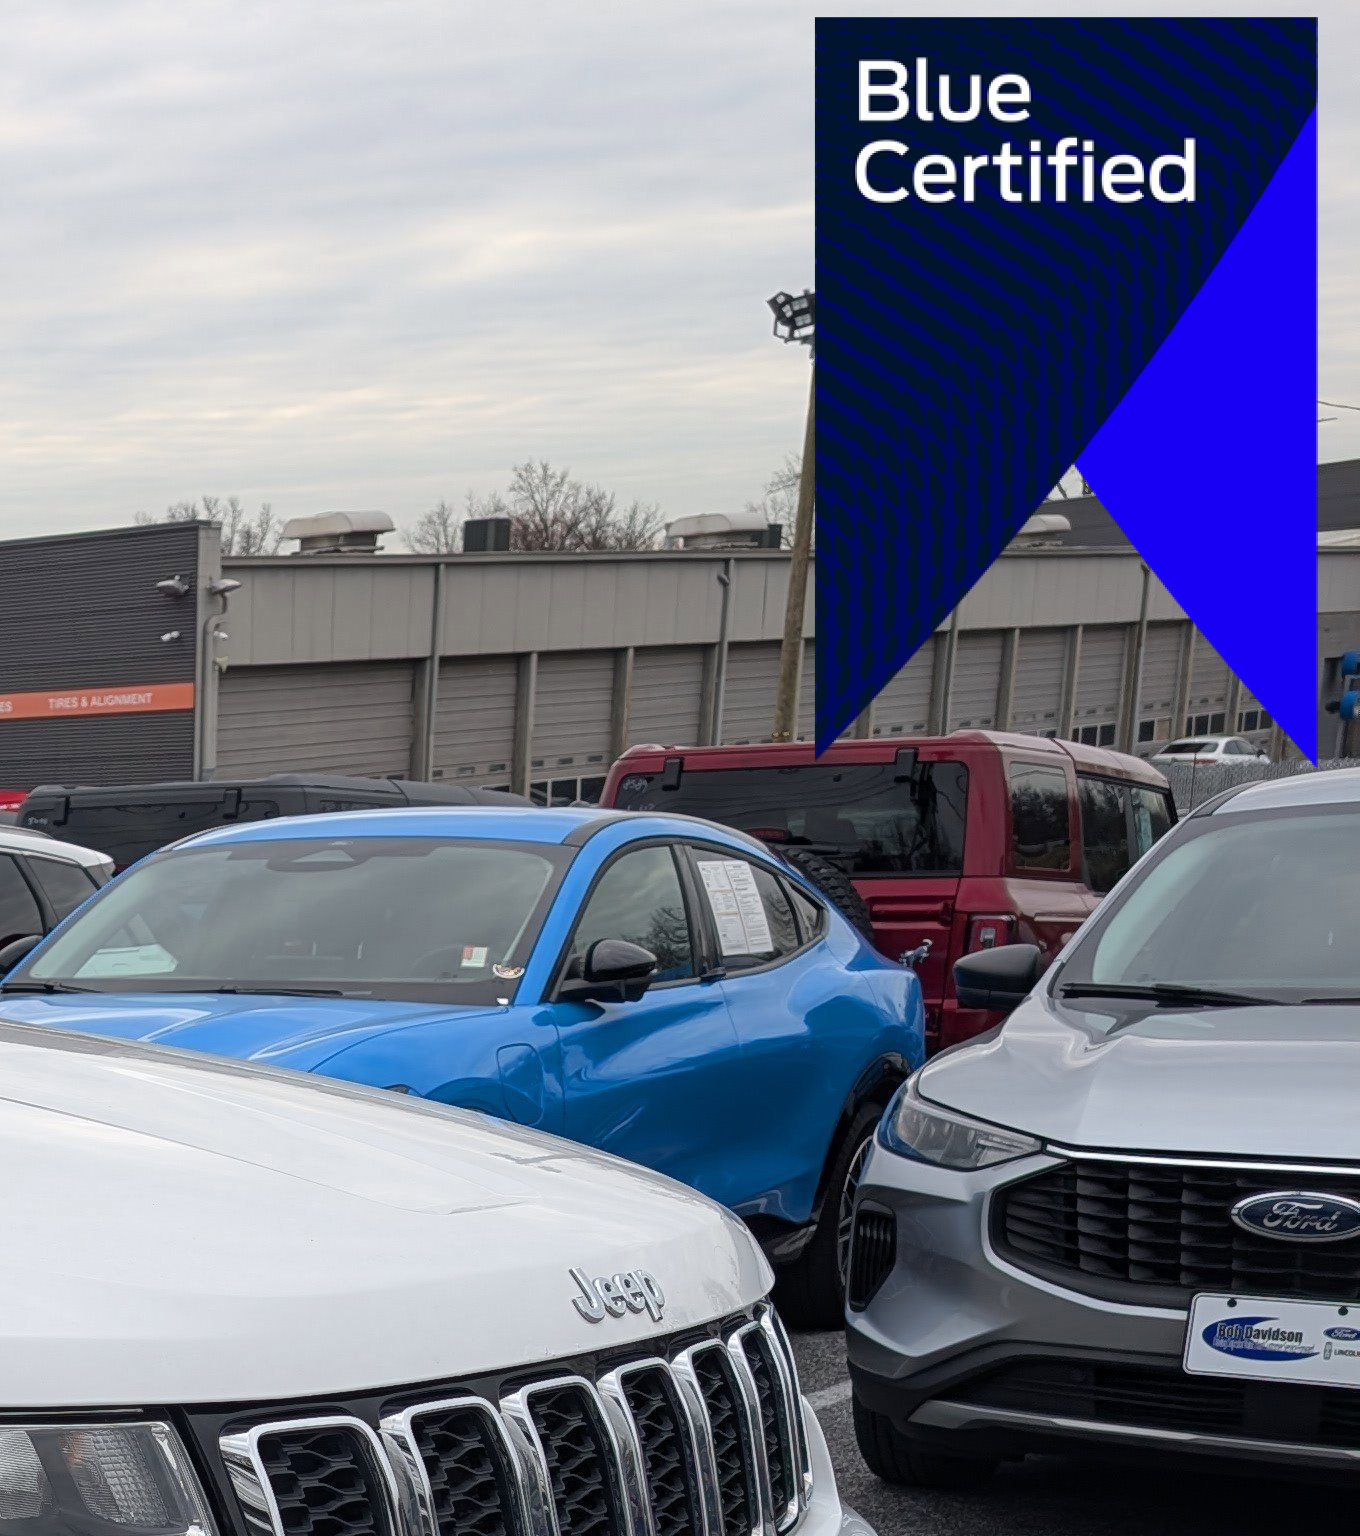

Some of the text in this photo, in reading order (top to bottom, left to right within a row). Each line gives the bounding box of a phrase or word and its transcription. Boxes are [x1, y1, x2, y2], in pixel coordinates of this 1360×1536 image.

[48, 692, 153, 710] TIRES & ALIGNMENT
[1262, 1200, 1342, 1231] Ford
[568, 1266, 666, 1324] Jeep
[1217, 1323, 1304, 1344] Bob Davidson
